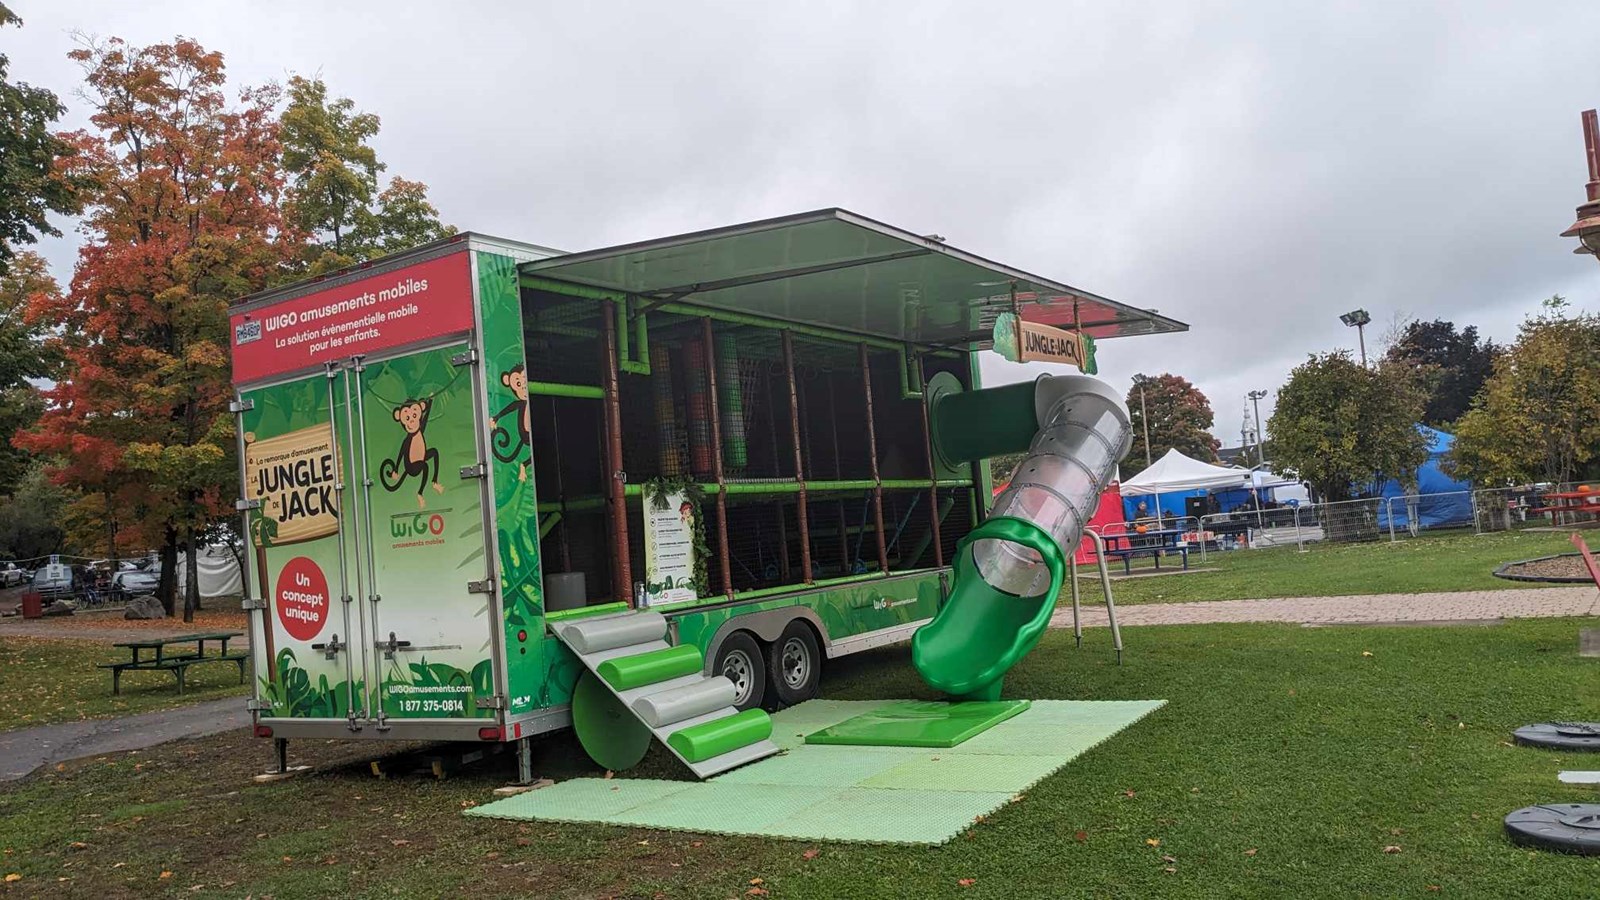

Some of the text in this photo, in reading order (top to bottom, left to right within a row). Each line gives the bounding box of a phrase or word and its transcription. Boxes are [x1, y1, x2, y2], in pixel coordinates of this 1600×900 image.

[265, 278, 428, 332] WIGO amusements mobiles
[275, 338, 286, 348] La
[287, 330, 320, 346] solution
[387, 303, 418, 321] mobile
[310, 329, 381, 356] pour les enfants.
[1025, 331, 1079, 361] JUNGLE JACK
[257, 455, 333, 495] JUNGLE
[279, 485, 339, 522] JACK
[295, 572, 310, 587] Un
[282, 590, 323, 608] concept
[285, 606, 319, 624] unique
[405, 701, 420, 712] 877
[422, 700, 464, 712] 375-0814
